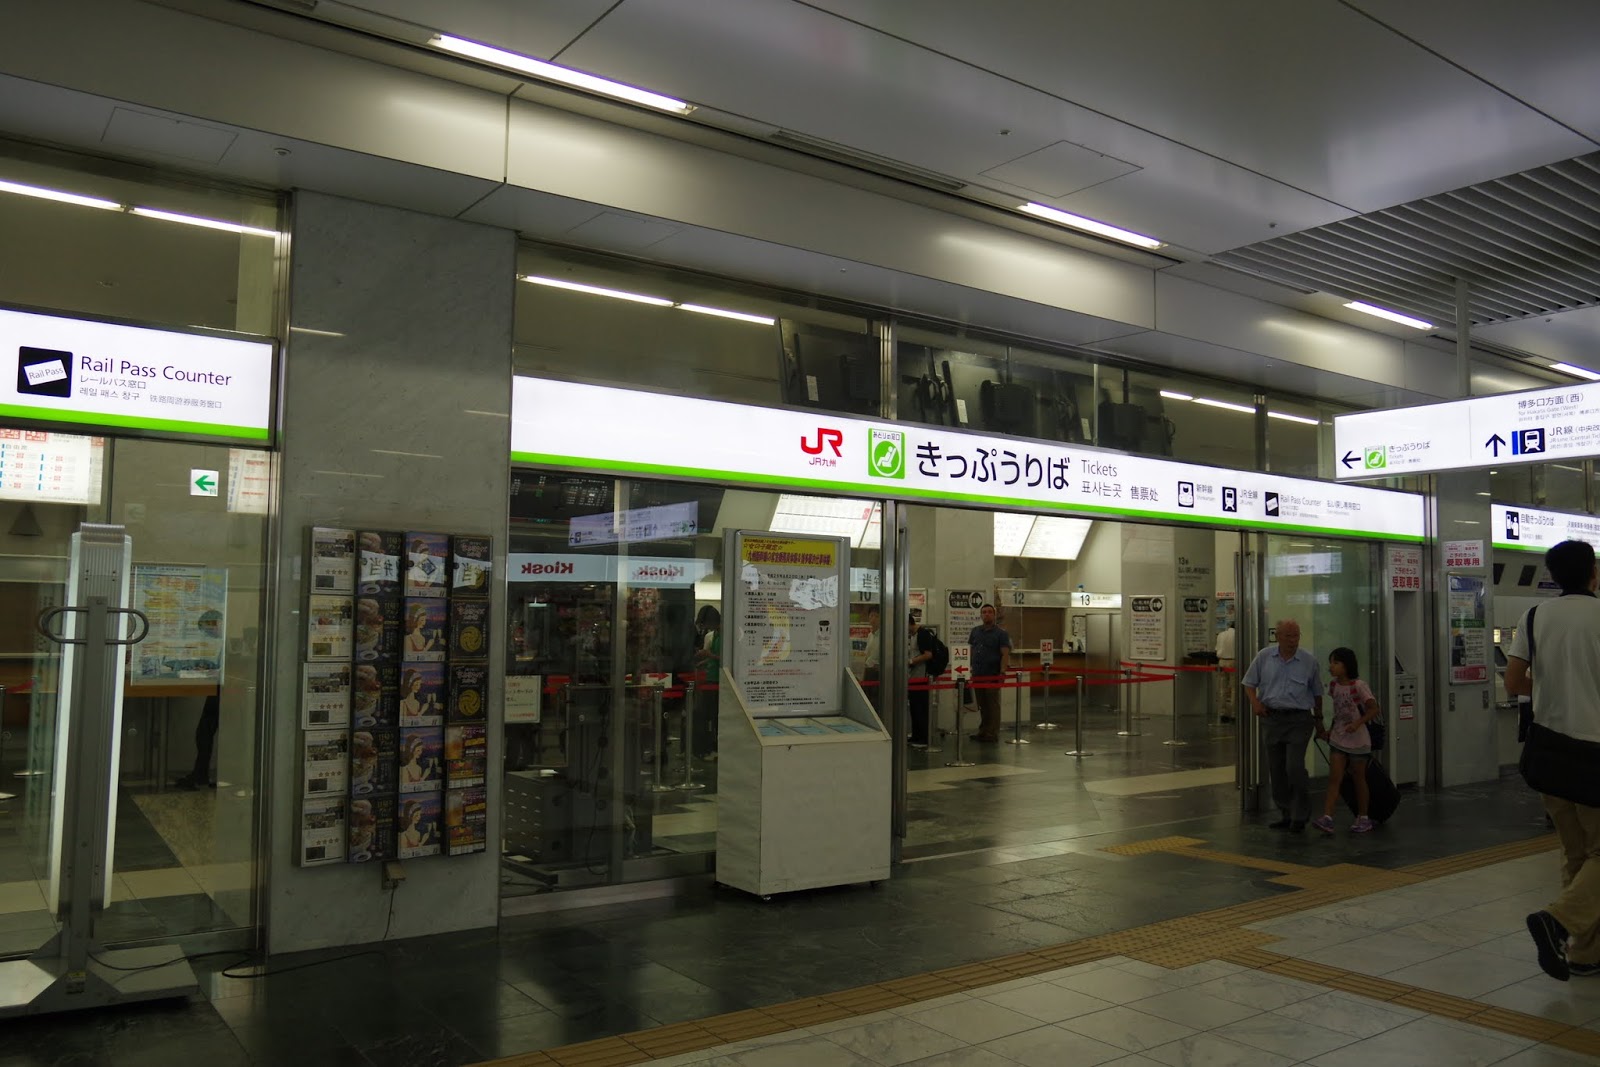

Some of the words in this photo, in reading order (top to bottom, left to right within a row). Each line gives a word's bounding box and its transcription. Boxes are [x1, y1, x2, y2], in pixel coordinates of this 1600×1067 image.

[28, 369, 45, 380] Rail
[45, 366, 64, 377] Pass
[81, 355, 114, 374] Rail
[120, 360, 157, 378] Pass
[162, 365, 233, 387] Counter
[800, 427, 844, 458] JR
[1388, 440, 1431, 453] きっぷうりば
[808, 456, 837, 468] JR九州
[916, 441, 1071, 491] きっぷうりば
[1081, 459, 1118, 478] Tickets
[1081, 480, 1123, 499] 표사는곳
[1130, 485, 1159, 502] 售票处
[1196, 483, 1213, 495] 新幹線
[1239, 489, 1259, 500] JR全線
[1280, 494, 1290, 503] Rail
[1291, 496, 1302, 505] Pass
[1302, 497, 1322, 507] Counter
[1446, 557, 1480, 567] 受取専用
[1392, 576, 1420, 589] 受取専用
[1012, 592, 1025, 605] 12
[1080, 594, 1091, 606] 13
[954, 648, 968, 656] 入口
[1041, 642, 1052, 652] 出口
